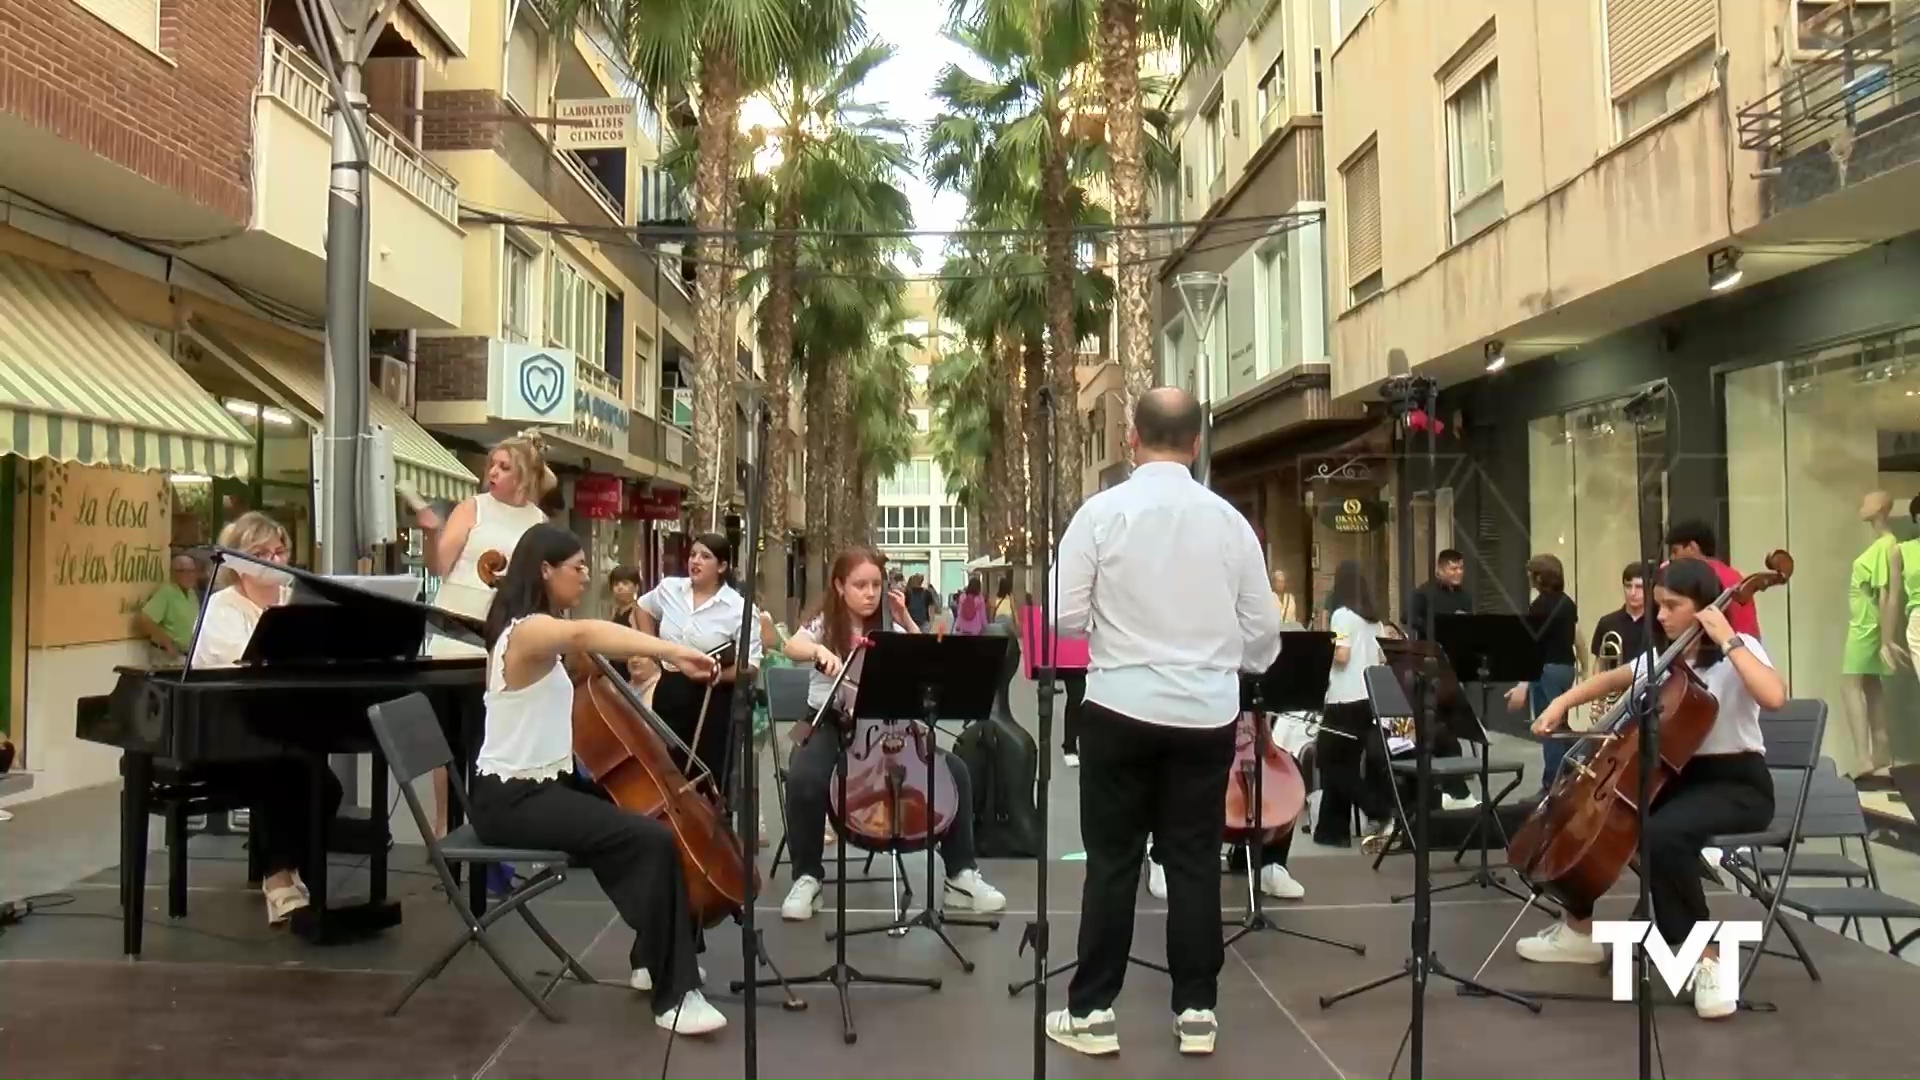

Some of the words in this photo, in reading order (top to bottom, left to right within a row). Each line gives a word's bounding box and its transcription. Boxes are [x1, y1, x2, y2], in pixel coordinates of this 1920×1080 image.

[563, 105, 632, 116] LABORATORIO
[570, 131, 624, 142] CLINICOS
[106, 487, 149, 528] Casa
[110, 541, 165, 584] Plantas
